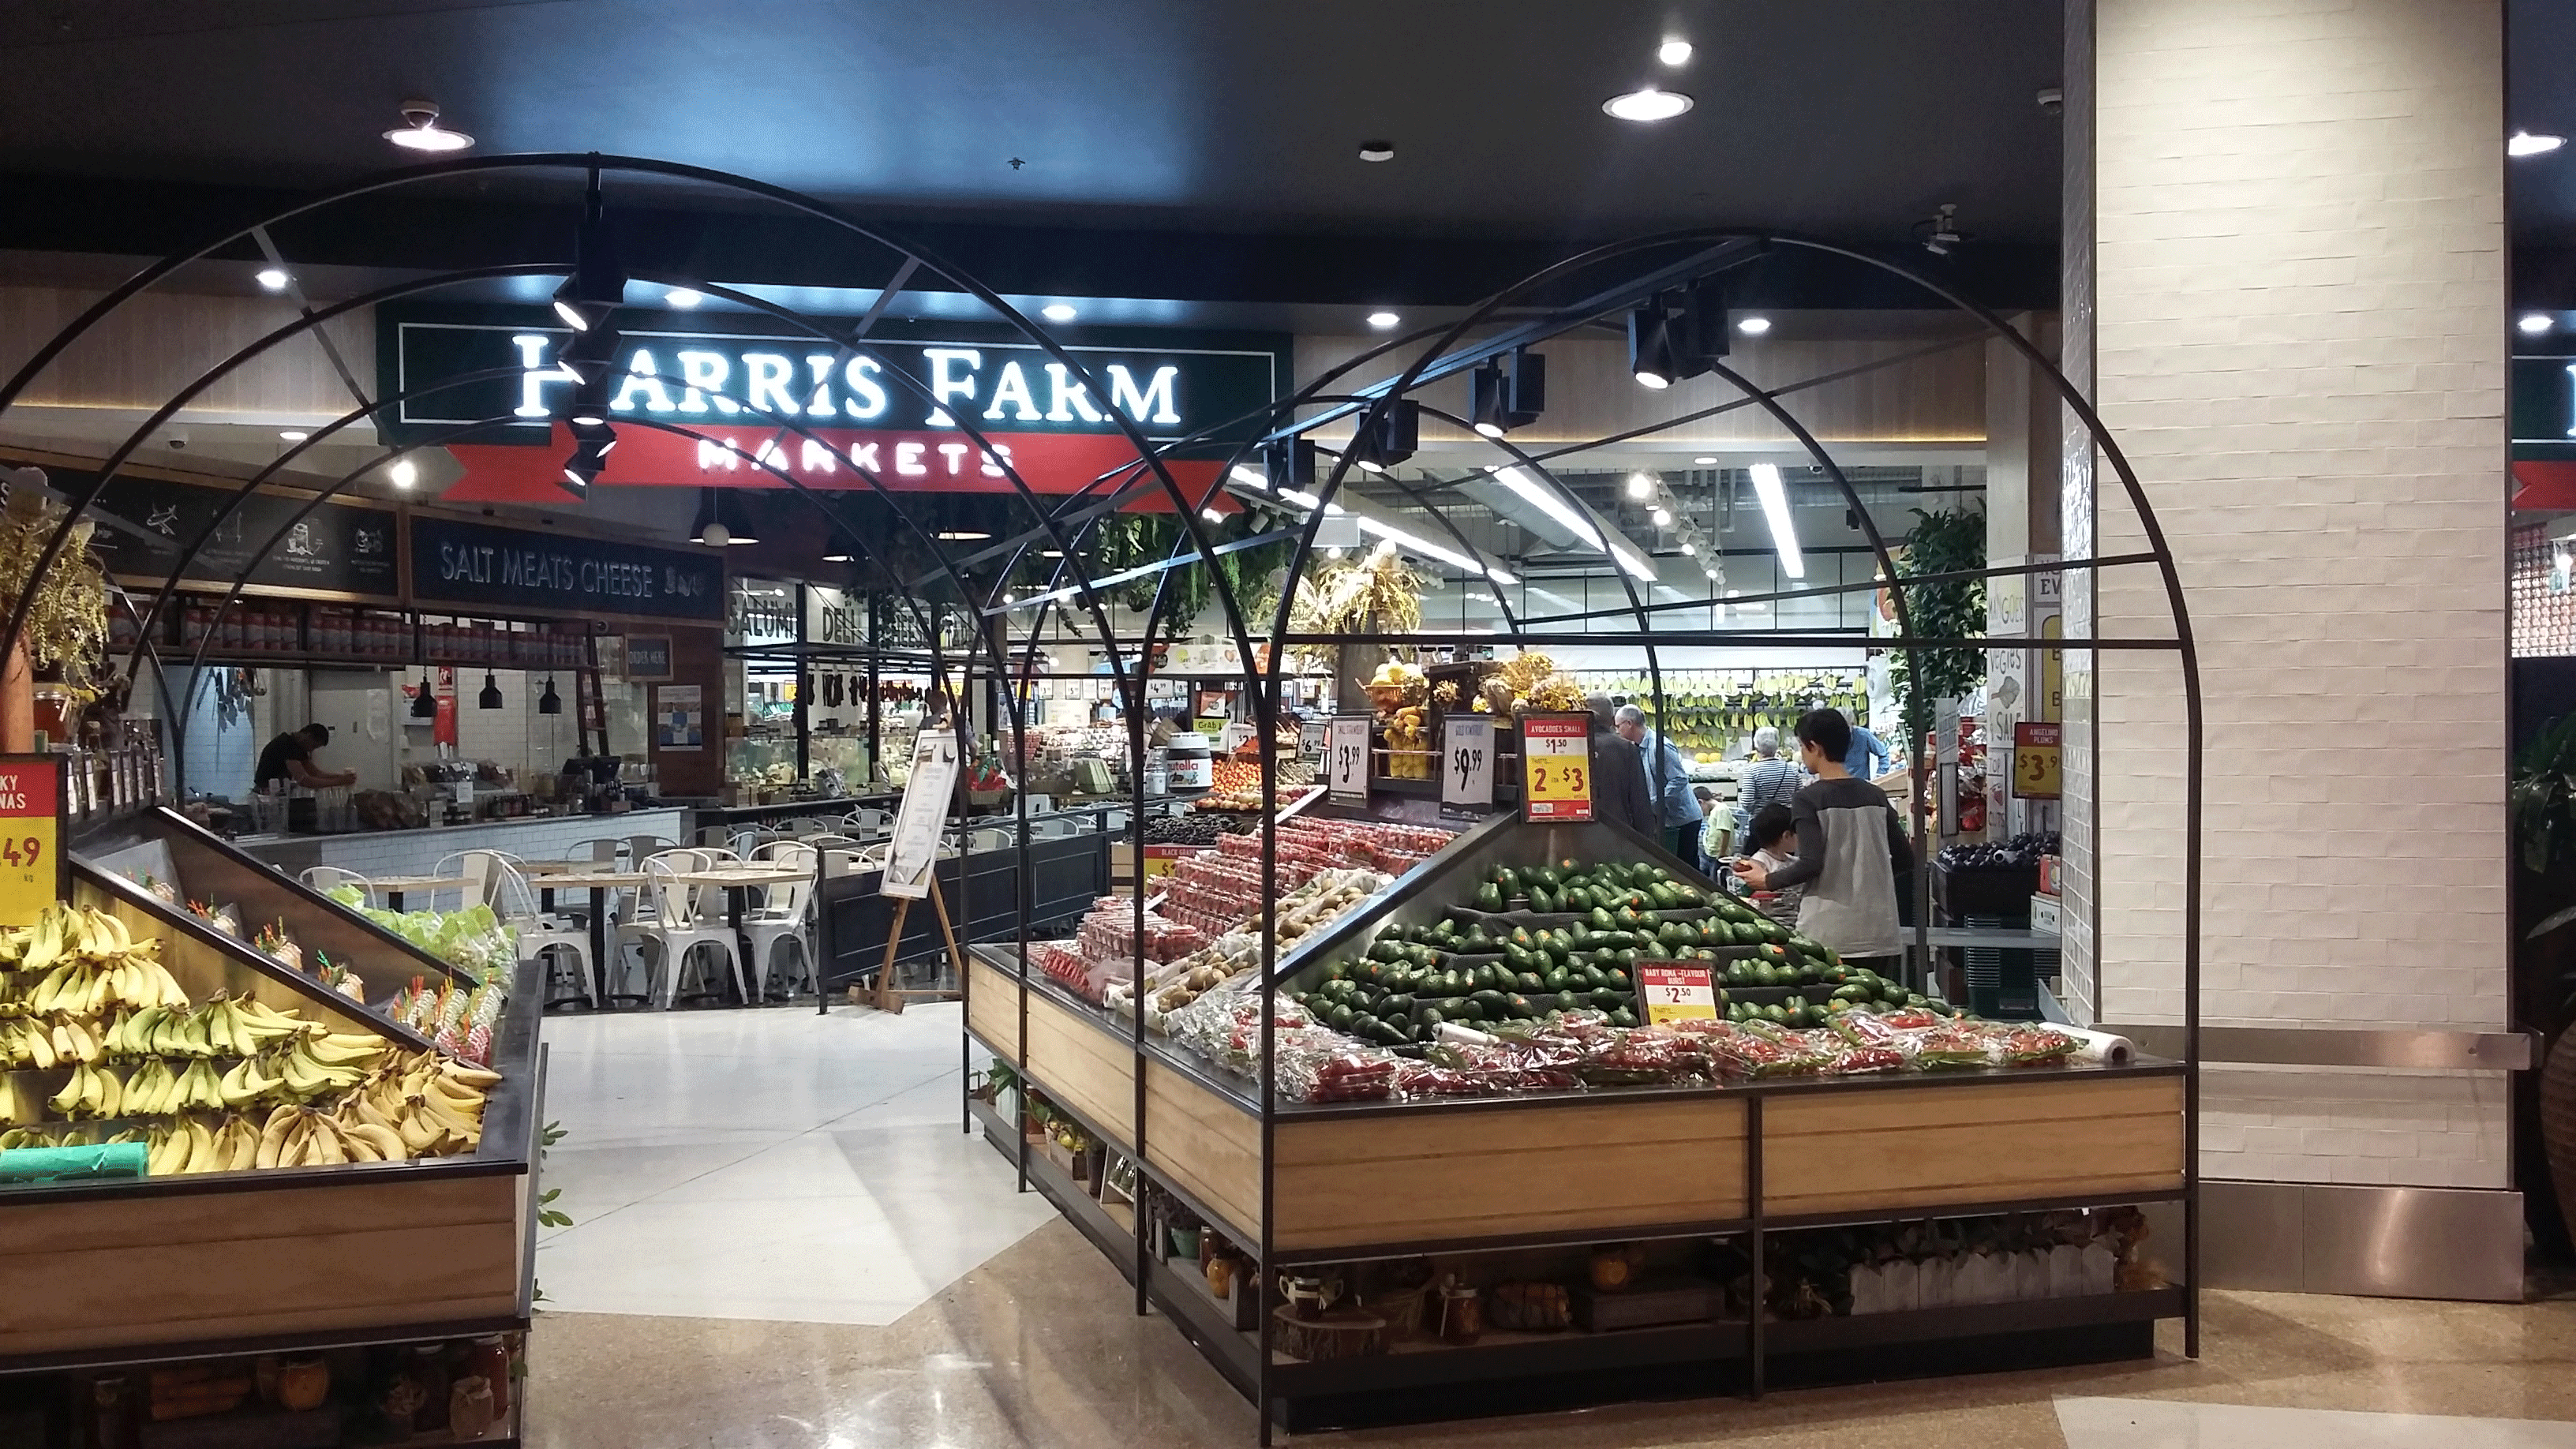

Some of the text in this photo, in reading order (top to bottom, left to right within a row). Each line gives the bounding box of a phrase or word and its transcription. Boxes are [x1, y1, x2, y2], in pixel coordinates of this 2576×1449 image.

[511, 335, 1181, 427] HARRIS FARM
[698, 437, 1013, 477] MARKETS
[440, 541, 653, 597] SALT MEATS CHEESE
[822, 606, 855, 644] DELI
[1563, 724, 1581, 733] SMALL
[1545, 739, 1567, 754] $1.50
[1339, 743, 1361, 784] $3.99
[1455, 746, 1483, 792] $9.99
[1534, 767, 1547, 792] 2
[1563, 766, 1584, 792] $3
[0, 774, 18, 790] KY
[1645, 968, 1660, 977] BABY
[1661, 968, 1676, 977] ROMA
[1665, 987, 1691, 1003] $2.50
